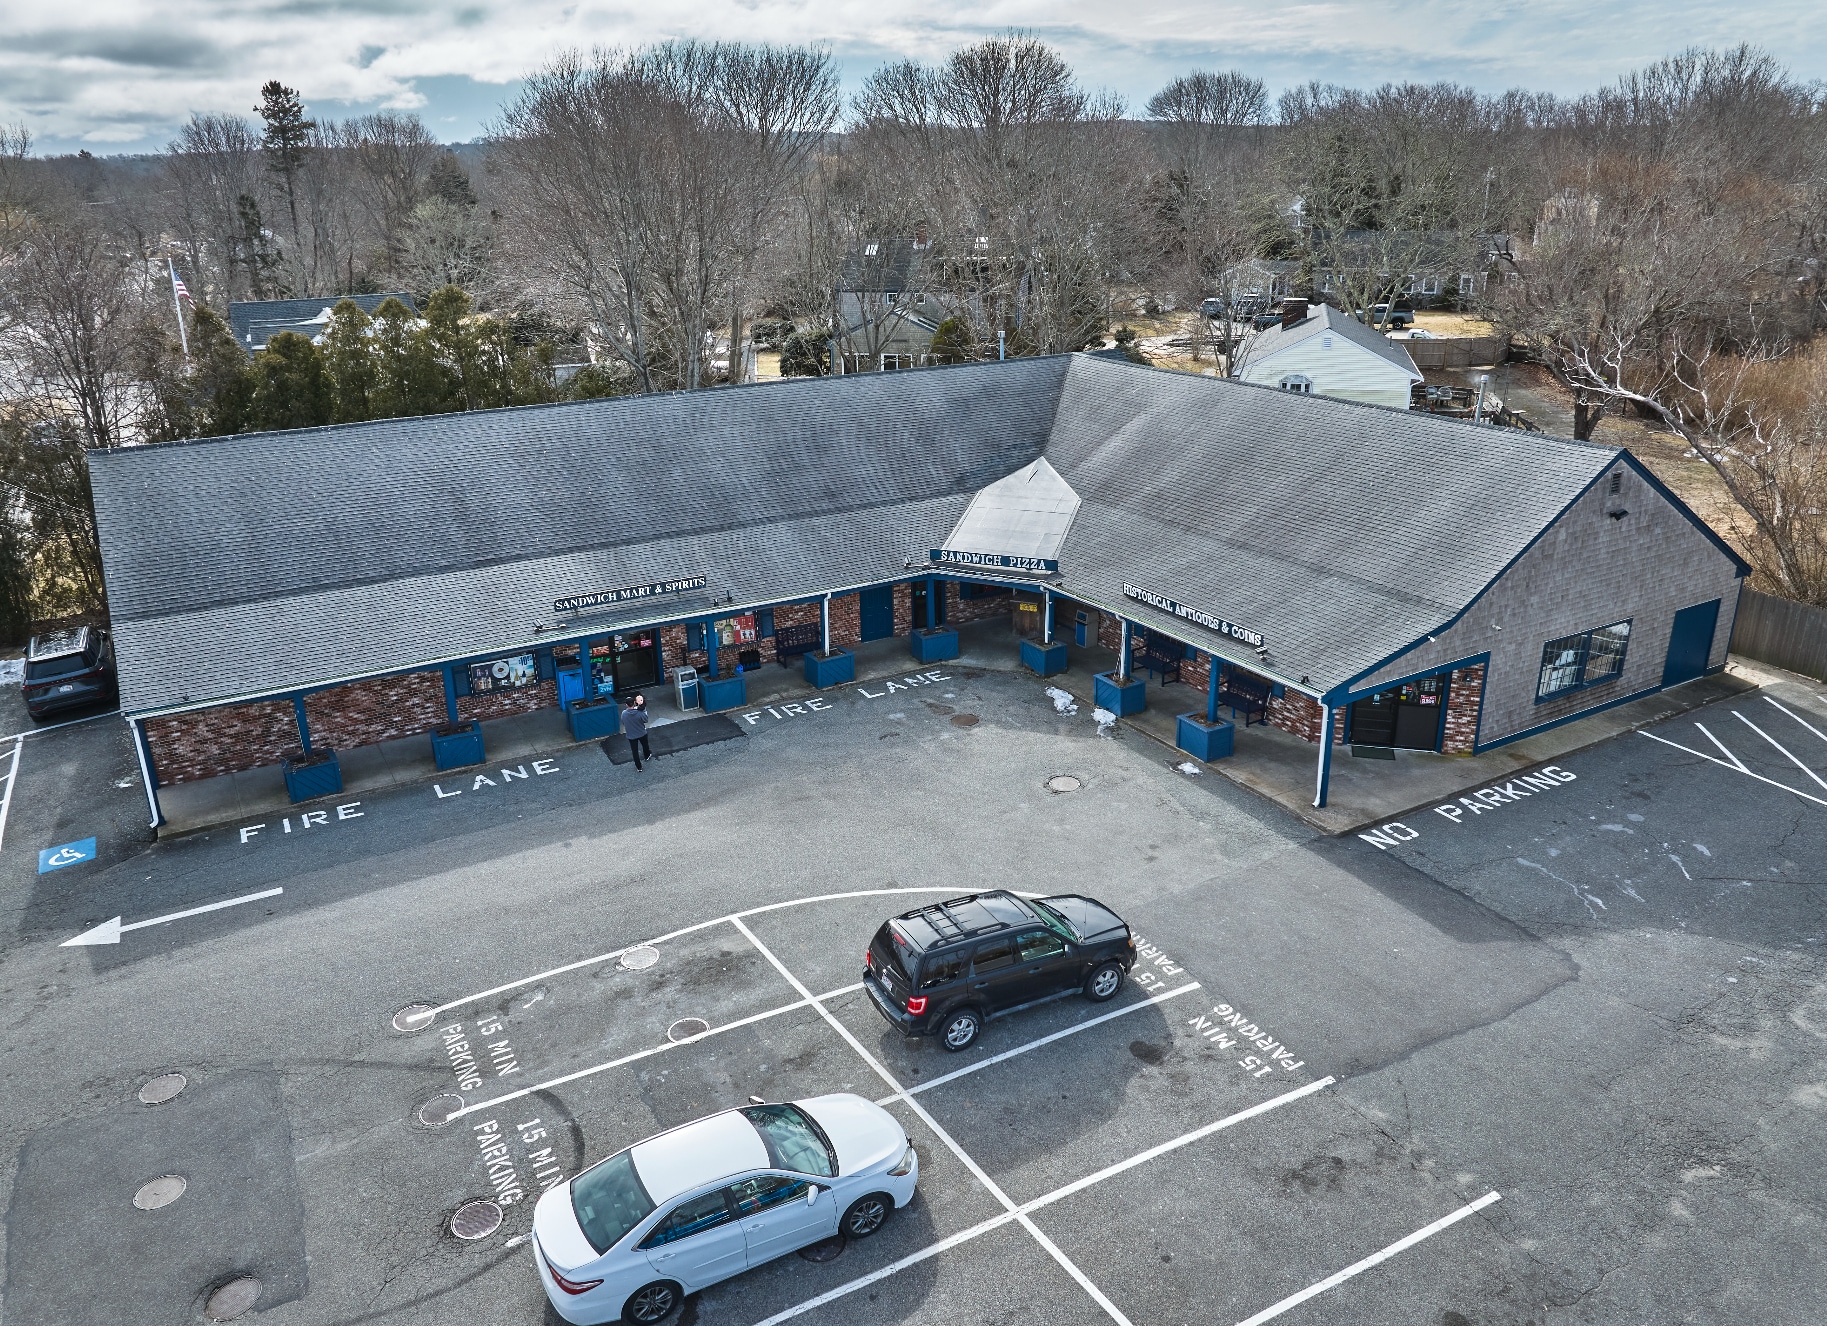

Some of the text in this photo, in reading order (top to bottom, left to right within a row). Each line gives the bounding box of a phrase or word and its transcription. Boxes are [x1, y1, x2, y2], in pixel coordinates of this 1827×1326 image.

[941, 550, 1046, 570] SANDWICH PIZZA
[555, 577, 706, 610] SANDWICH MART & SPIRITS
[1123, 582, 1262, 646] HISTORICAL ANTIQUES & COINS
[742, 670, 952, 725] FIRE LANE
[239, 758, 560, 844] FIRE LANE
[1357, 765, 1577, 851] NO PARKING
[1130, 931, 1184, 976] PARK
[1134, 972, 1166, 992] 15
[439, 1022, 483, 1091] PARKING
[476, 1015, 520, 1077] 15 MIN
[1188, 1015, 1273, 1078] 15 MIN
[1213, 1003, 1305, 1071] PARKING
[517, 1118, 547, 1143] 15
[473, 1119, 523, 1205] PARKING
